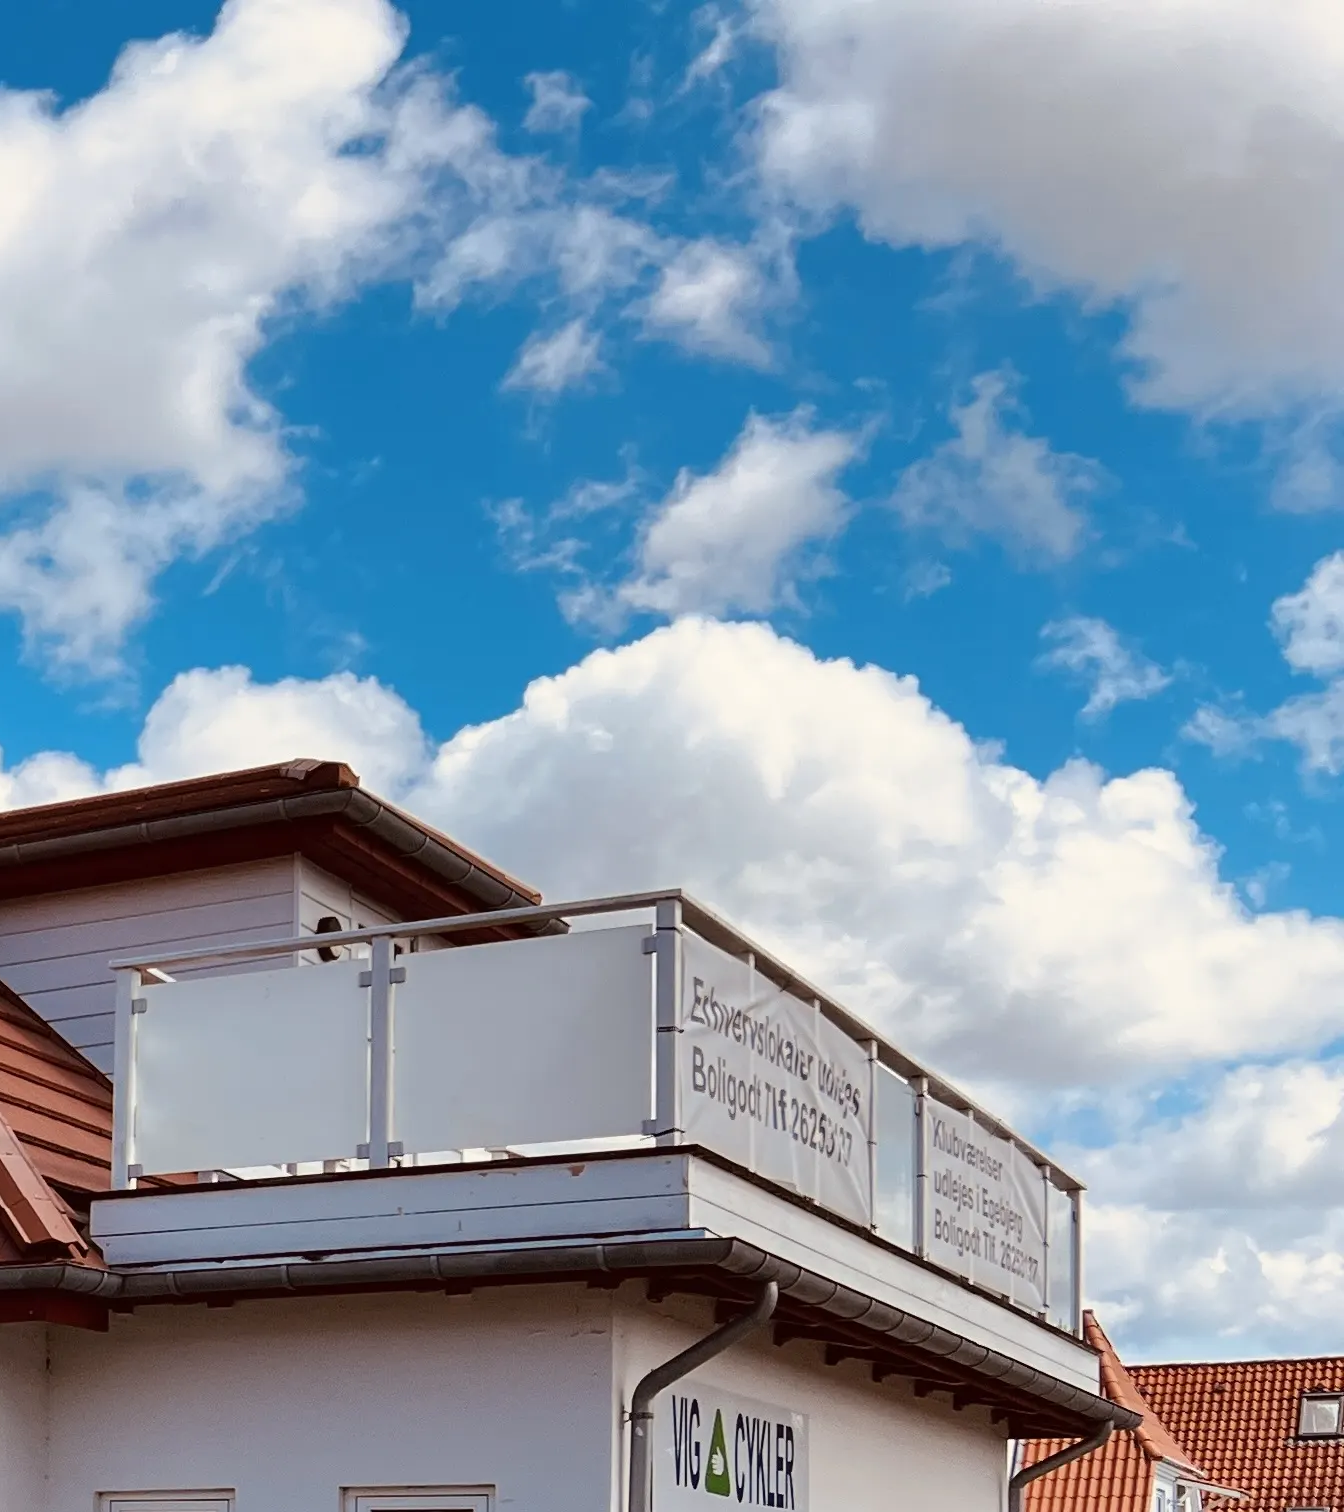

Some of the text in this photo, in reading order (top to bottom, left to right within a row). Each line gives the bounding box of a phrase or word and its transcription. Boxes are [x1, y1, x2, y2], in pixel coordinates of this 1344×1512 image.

[691, 976, 813, 1081] Erhvervslokaler
[692, 1045, 762, 1121] Boligodt
[932, 1117, 1004, 1182] Klubværelser
[933, 1168, 1023, 1243] udlejes i Egebjerg
[934, 1208, 981, 1258] Boligodt
[672, 1394, 795, 1511] VIG CYKLER
